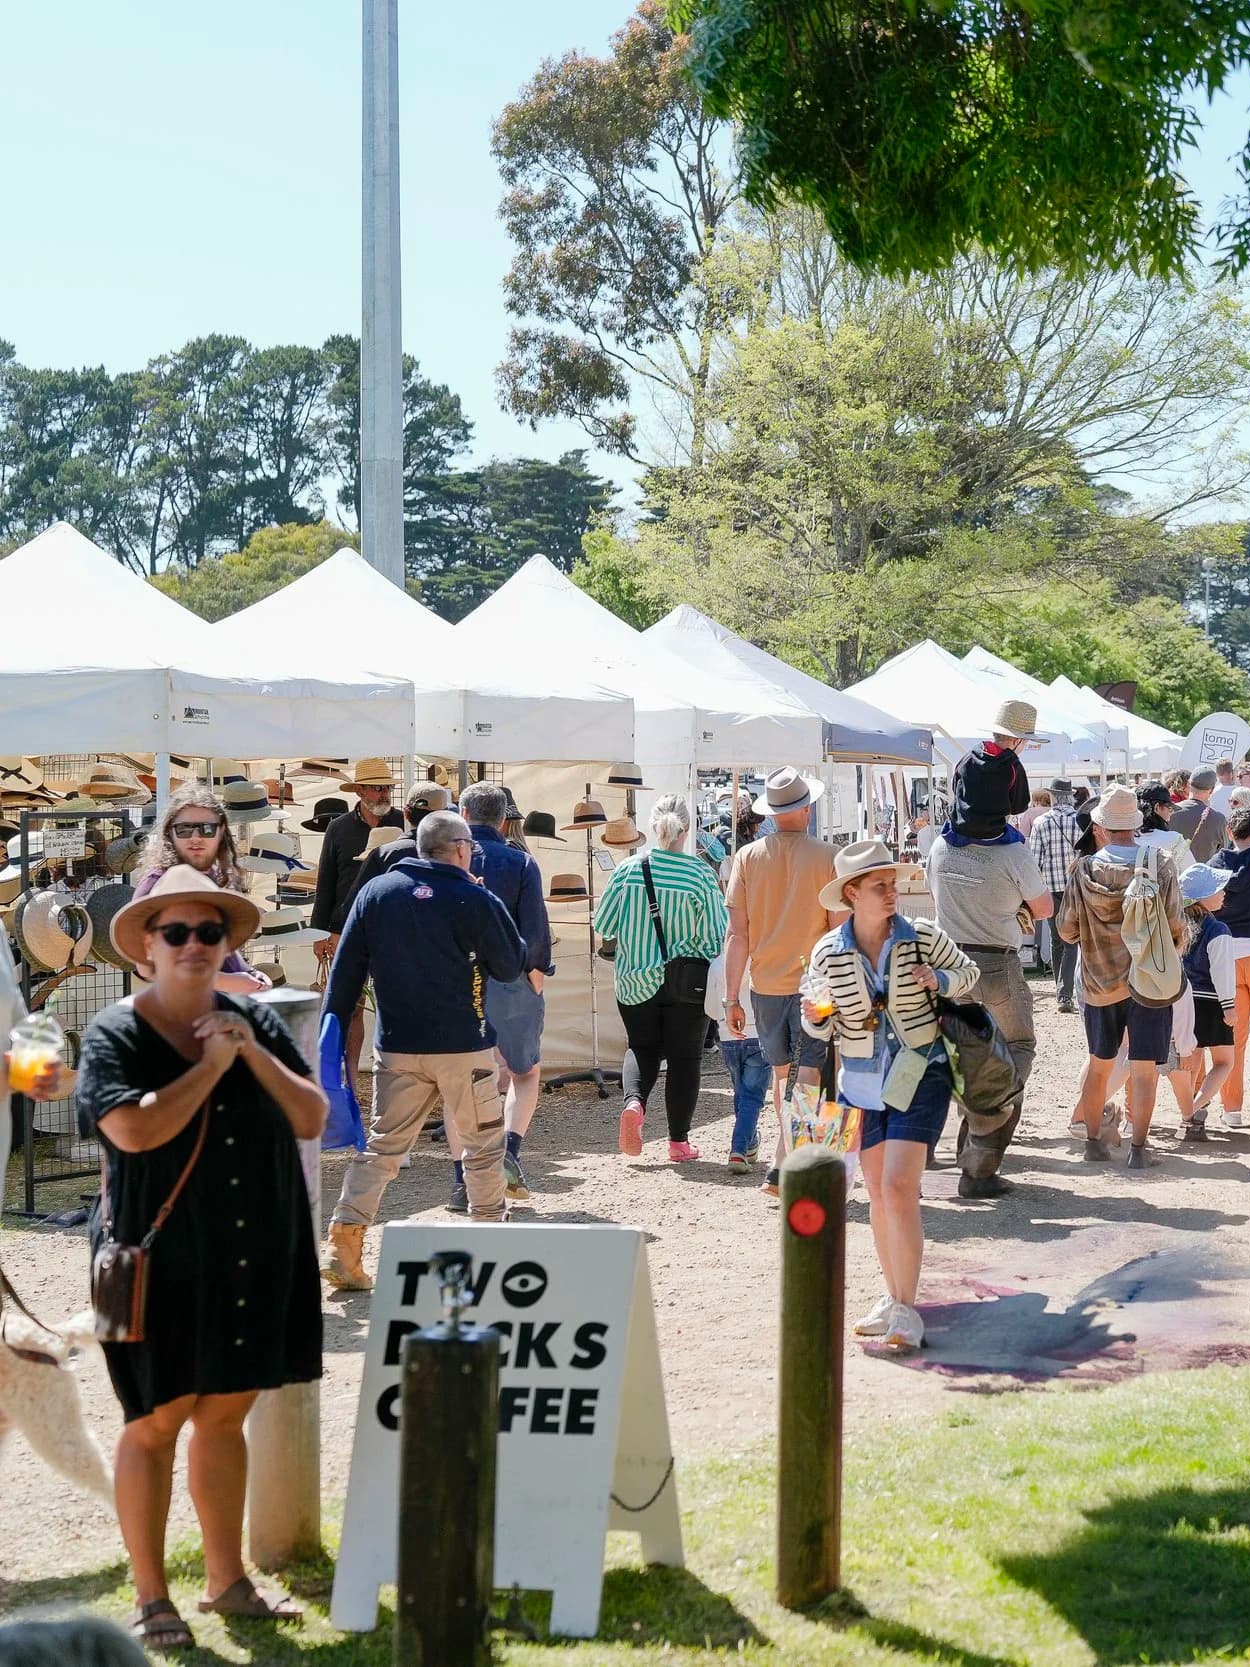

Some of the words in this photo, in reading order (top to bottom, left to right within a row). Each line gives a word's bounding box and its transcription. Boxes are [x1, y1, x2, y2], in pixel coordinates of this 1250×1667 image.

[1205, 733, 1234, 745] tomo
[412, 887, 433, 897] AFL
[384, 1320, 609, 1370] DCKS
[376, 1384, 599, 1435] CFEE
